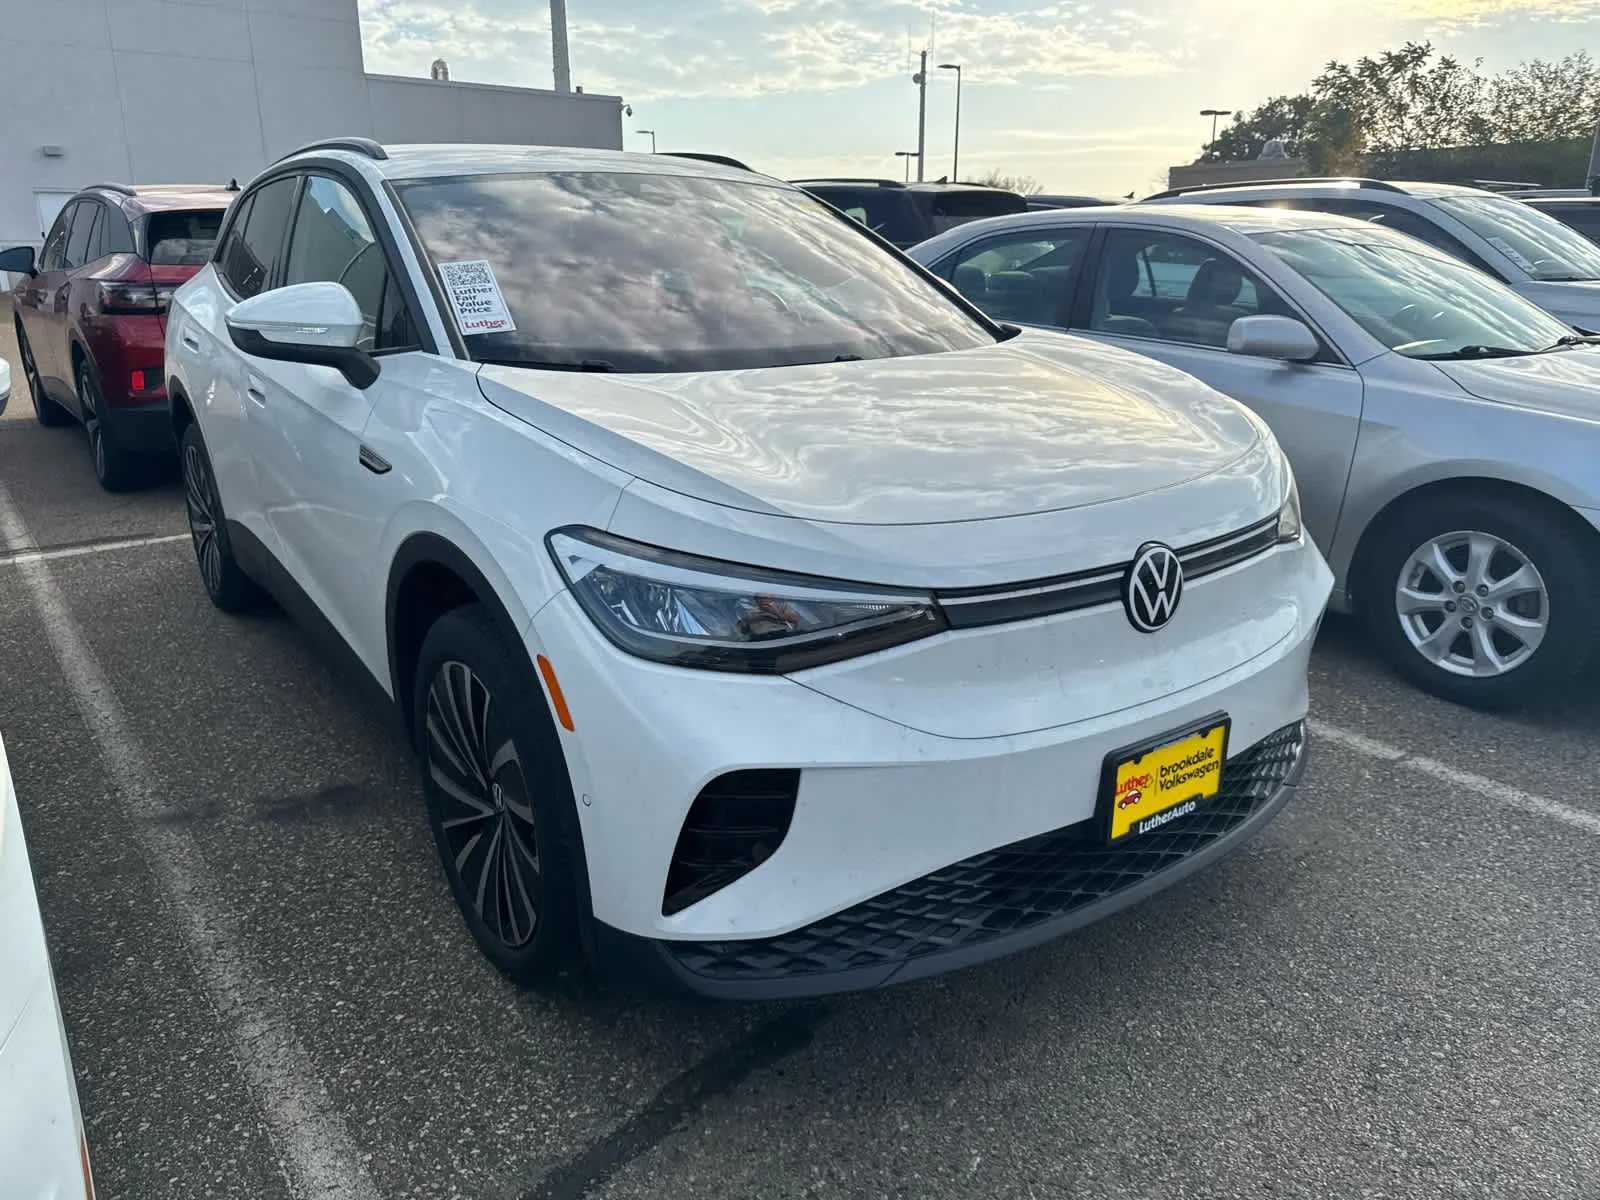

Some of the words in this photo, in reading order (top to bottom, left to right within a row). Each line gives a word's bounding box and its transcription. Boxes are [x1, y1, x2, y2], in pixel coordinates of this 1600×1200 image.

[453, 287, 492, 295] Luther
[465, 320, 505, 328] Luther
[1159, 760, 1219, 792] Volkswagen
[1160, 747, 1214, 778] brookdale
[1115, 773, 1150, 796] Luther
[1138, 801, 1196, 834] LutherAuto
